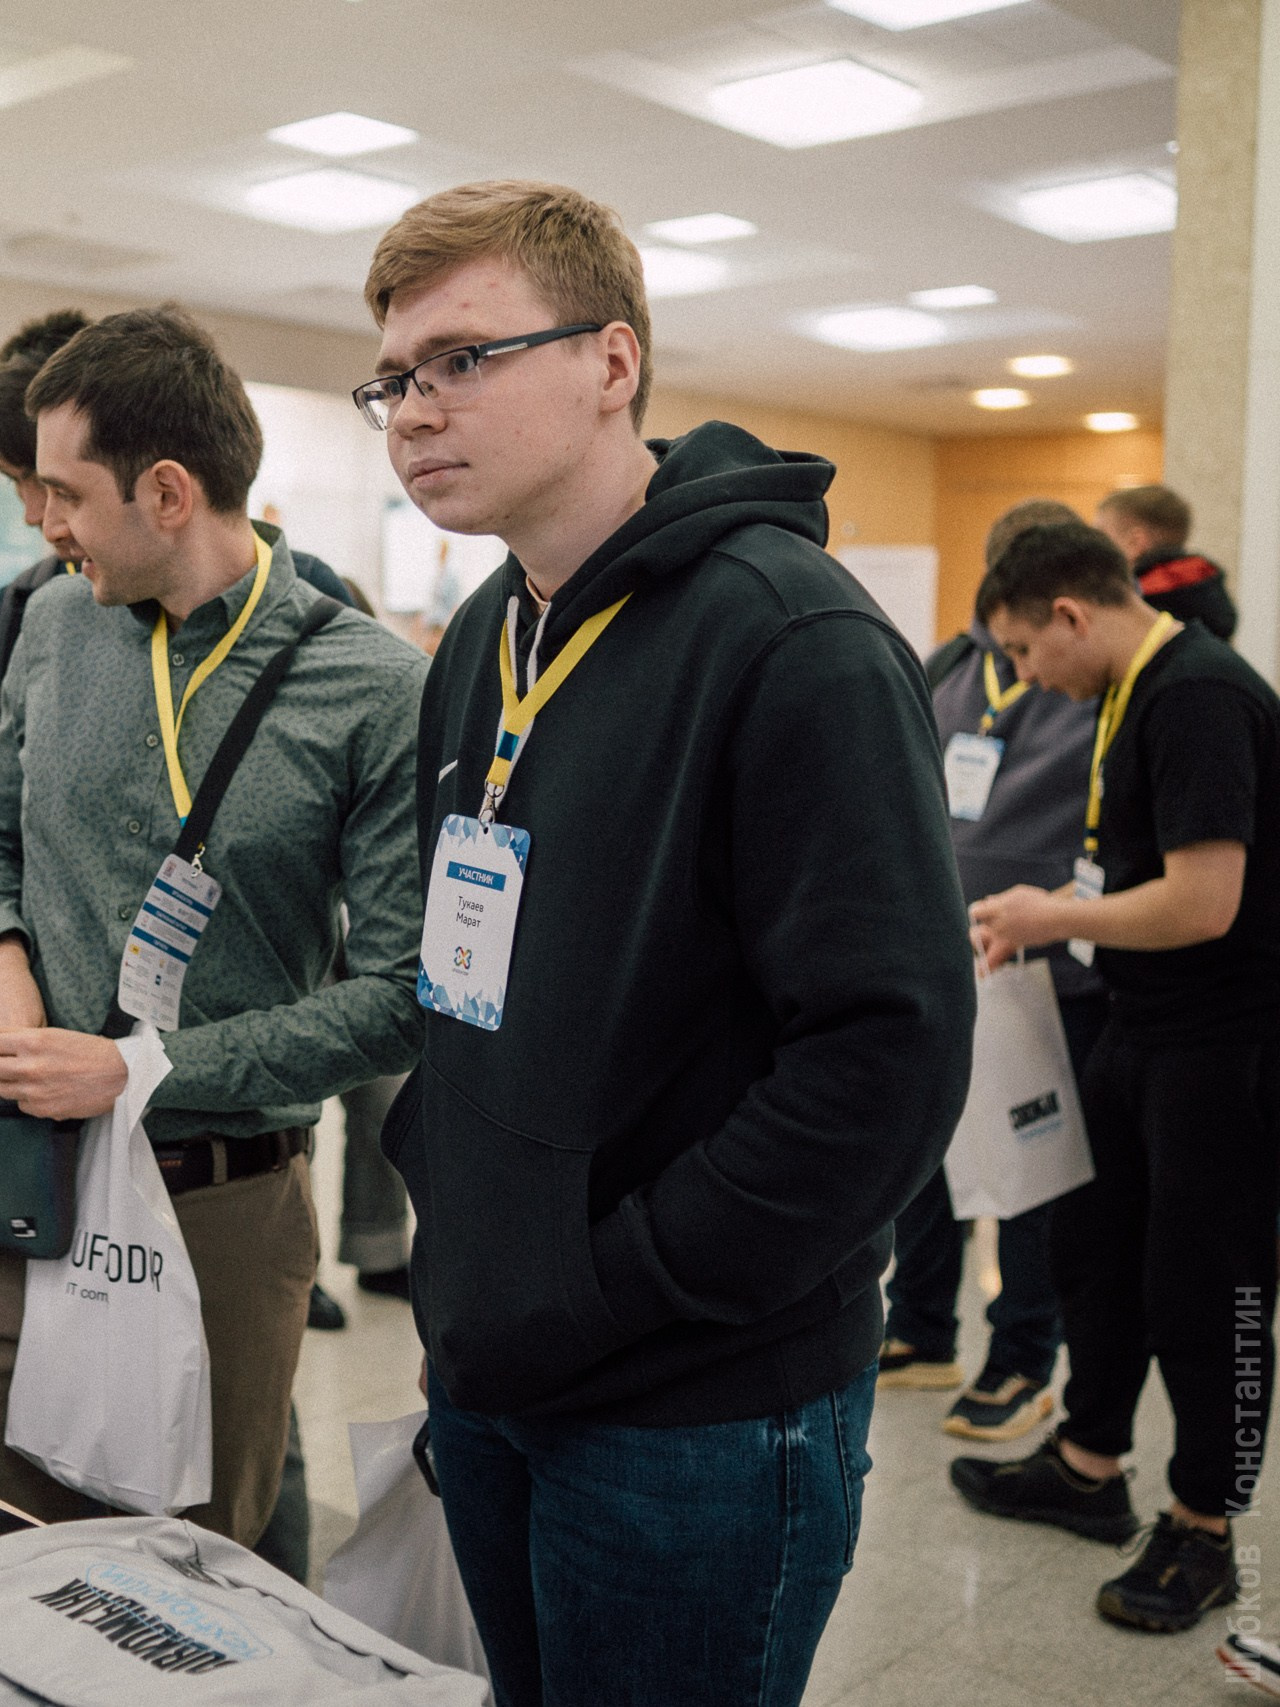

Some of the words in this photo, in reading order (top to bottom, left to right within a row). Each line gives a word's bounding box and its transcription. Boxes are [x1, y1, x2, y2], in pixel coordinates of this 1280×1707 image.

[458, 867, 494, 885] УЧАСТНИК
[458, 895, 484, 913] Тукаев
[456, 912, 481, 928] Марат
